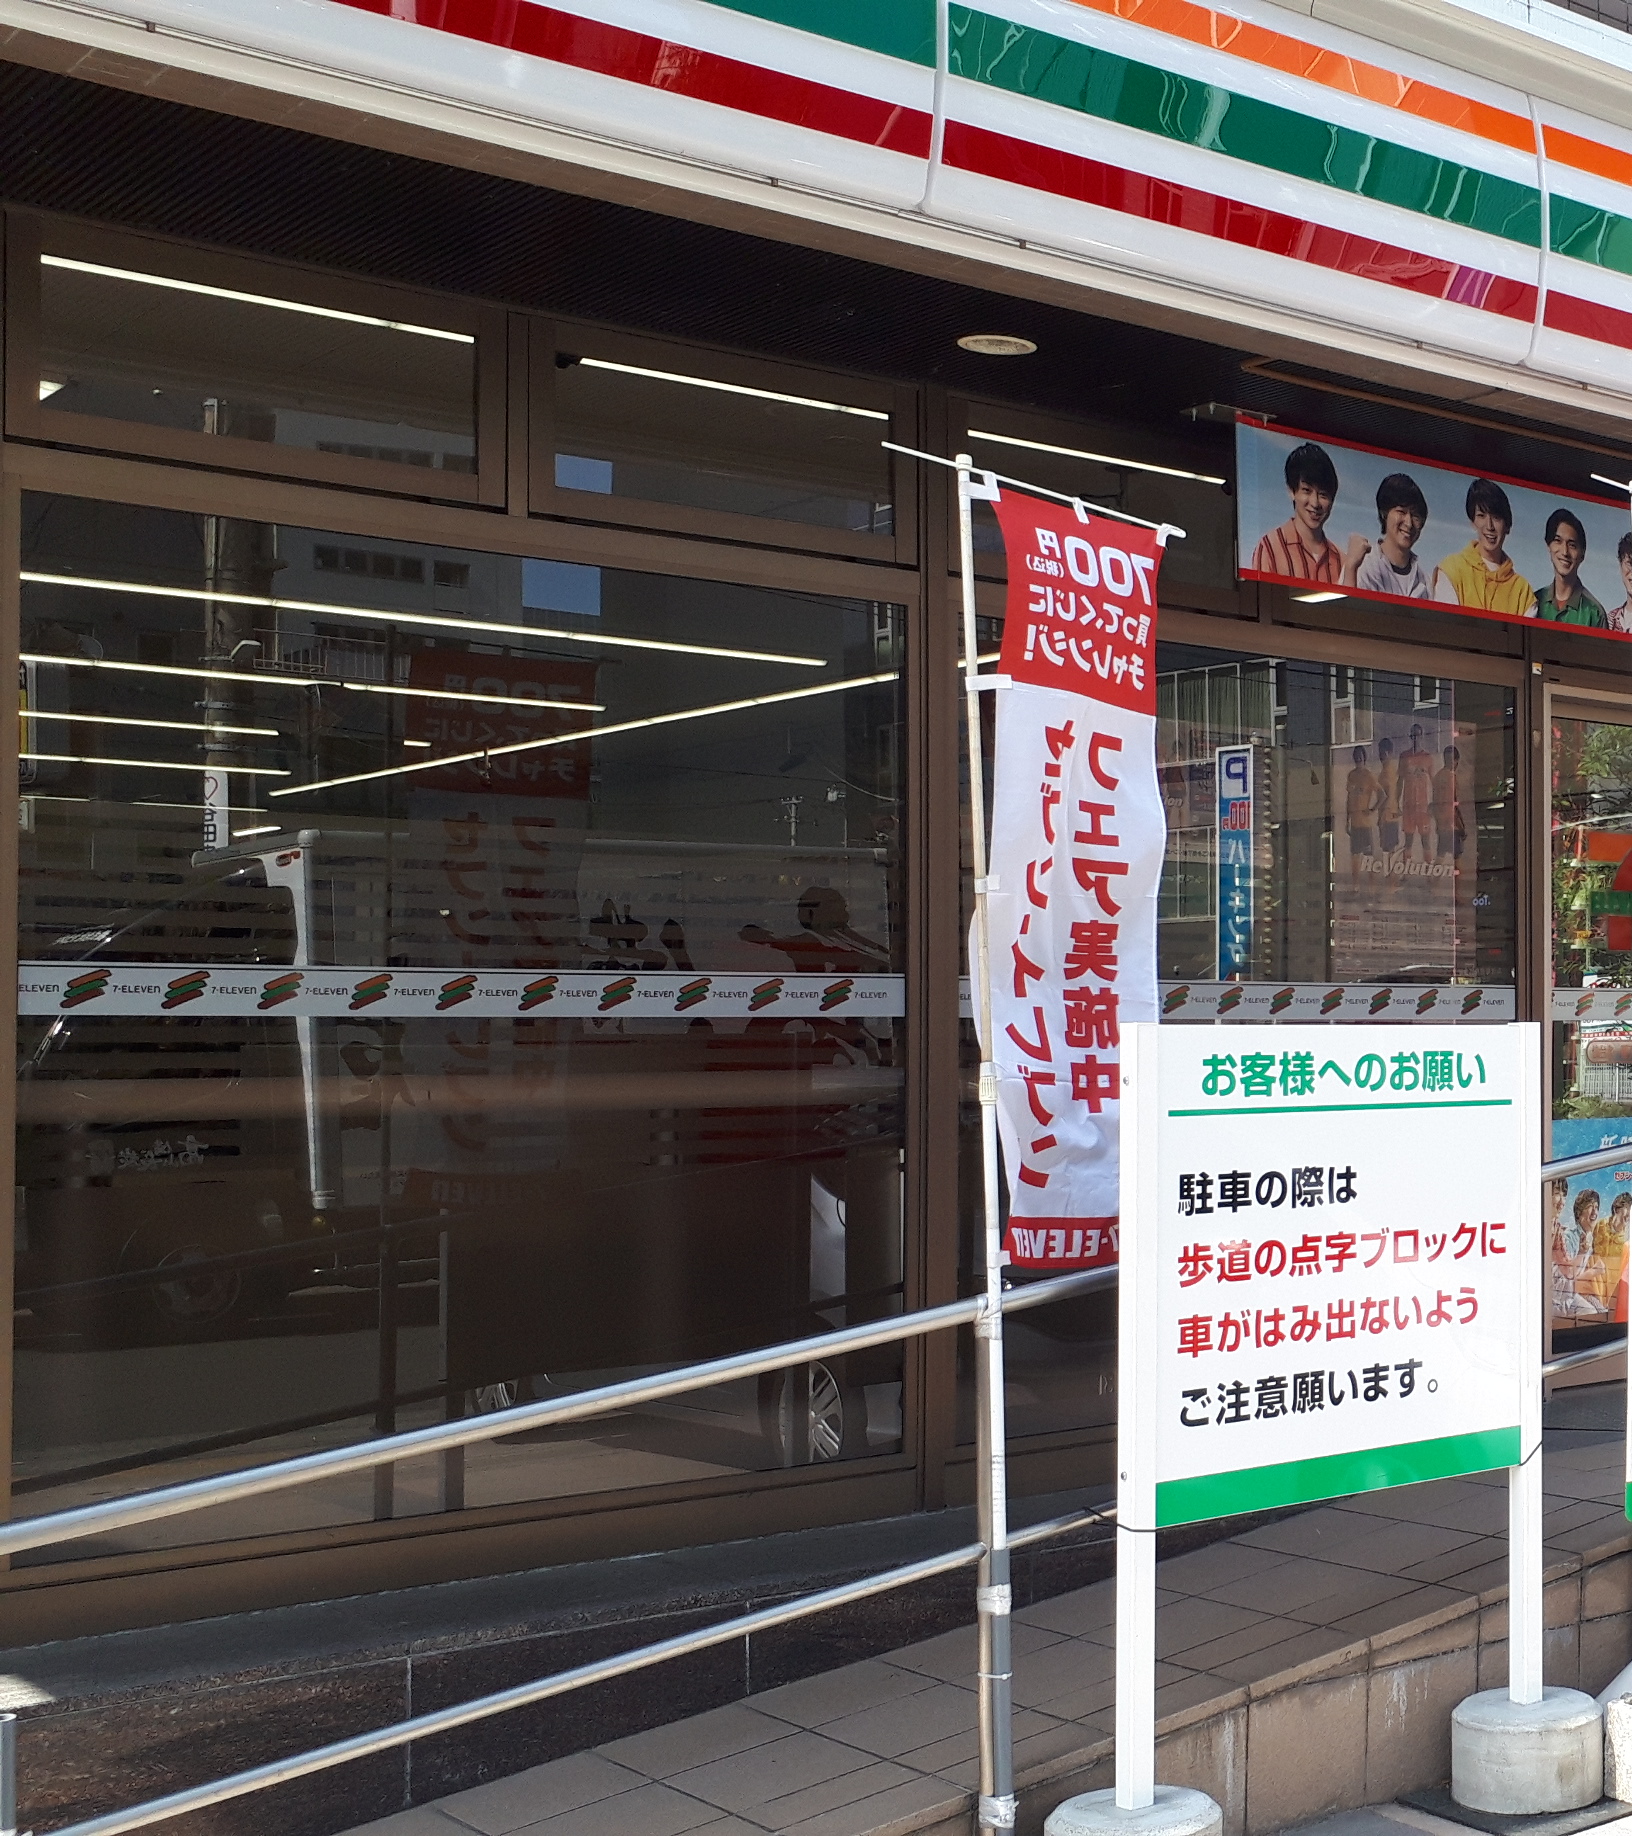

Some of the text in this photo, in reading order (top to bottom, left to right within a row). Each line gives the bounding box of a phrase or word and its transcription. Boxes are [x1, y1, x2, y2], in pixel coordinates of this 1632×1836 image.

[1201, 1050, 1487, 1098] お客様へのお願い
[1176, 1165, 1358, 1217] 駐車の際は
[1177, 1221, 1507, 1288] 歩道の点字ブロックに
[1176, 1286, 1479, 1359] 車がはみ出ないよう
[1179, 1358, 1439, 1428] ご注意願います。
